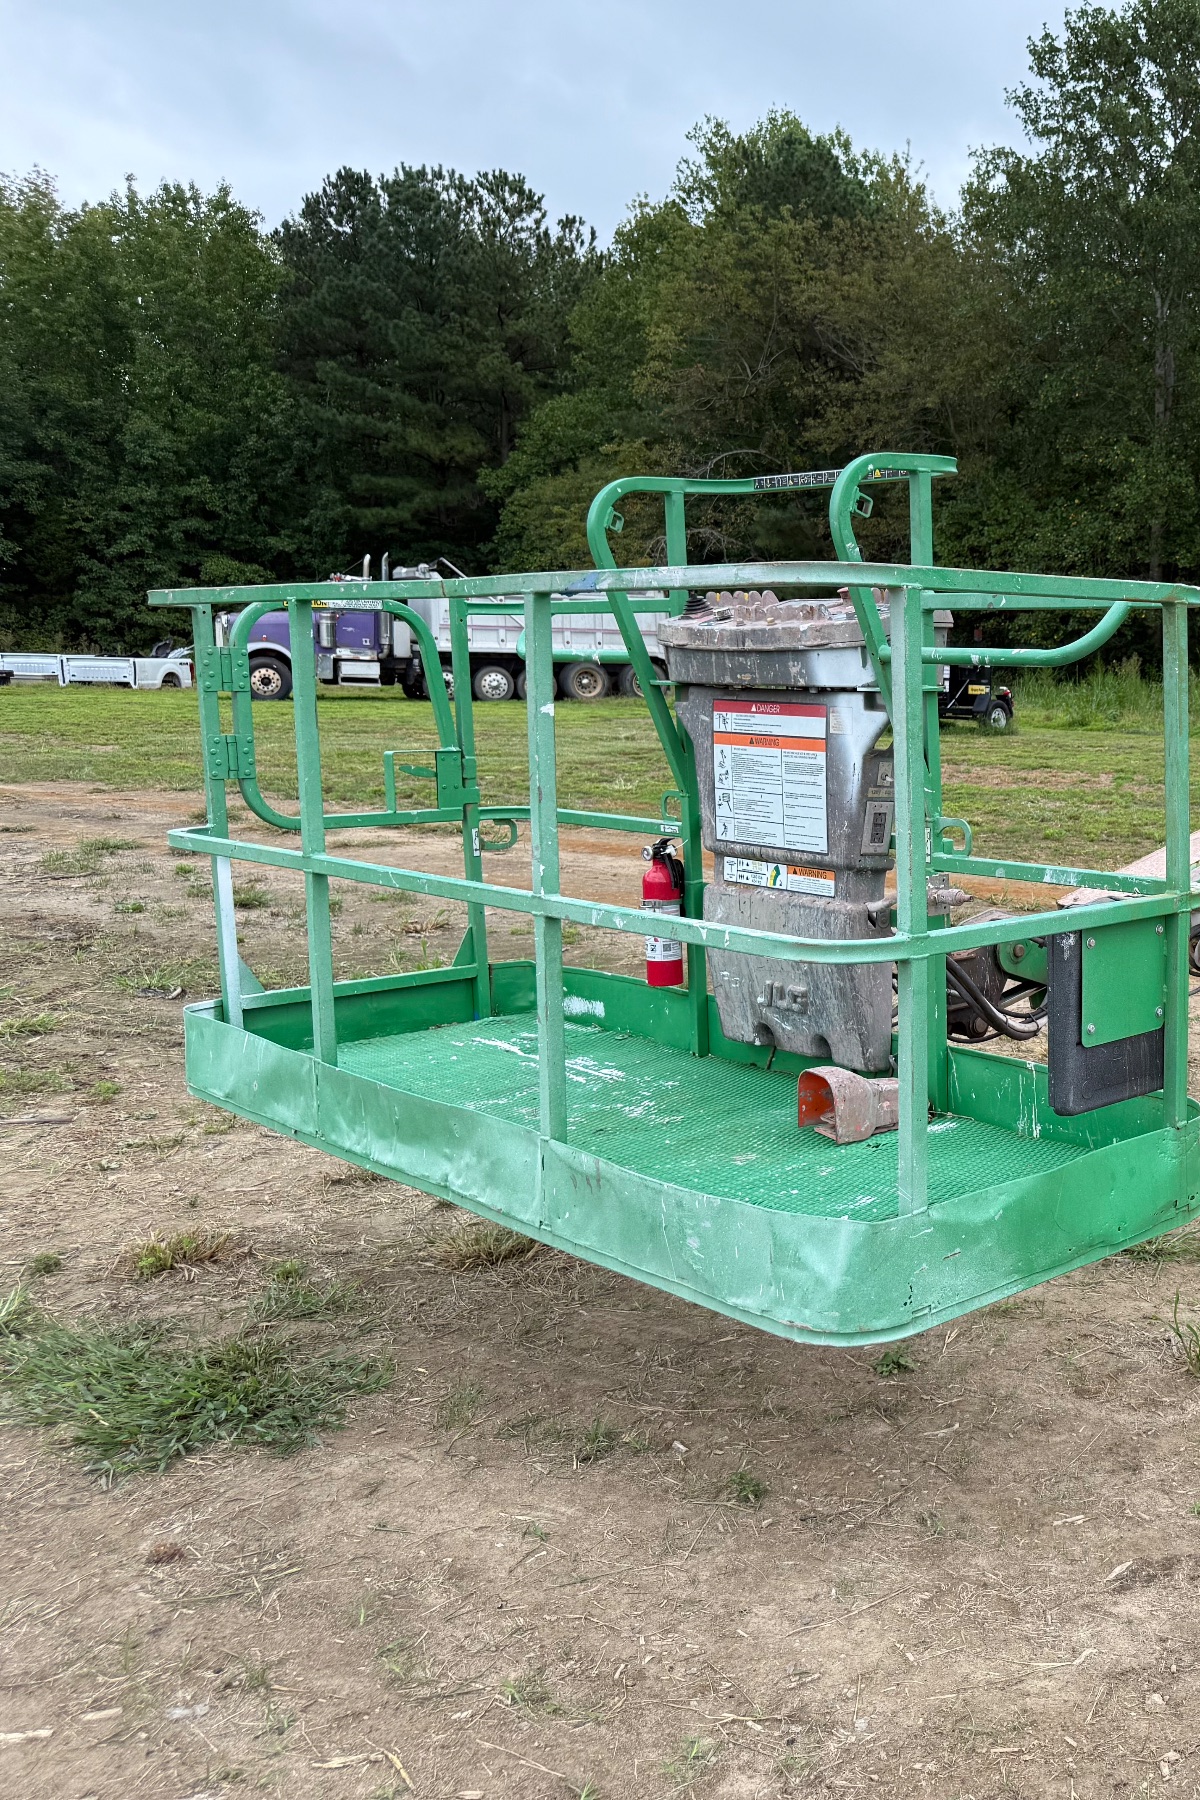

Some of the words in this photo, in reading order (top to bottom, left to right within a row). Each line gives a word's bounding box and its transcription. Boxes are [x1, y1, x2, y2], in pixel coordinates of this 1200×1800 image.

[757, 704, 780, 713] DANGER
[754, 737, 780, 747] WARNING
[798, 868, 827, 880] WARNING
